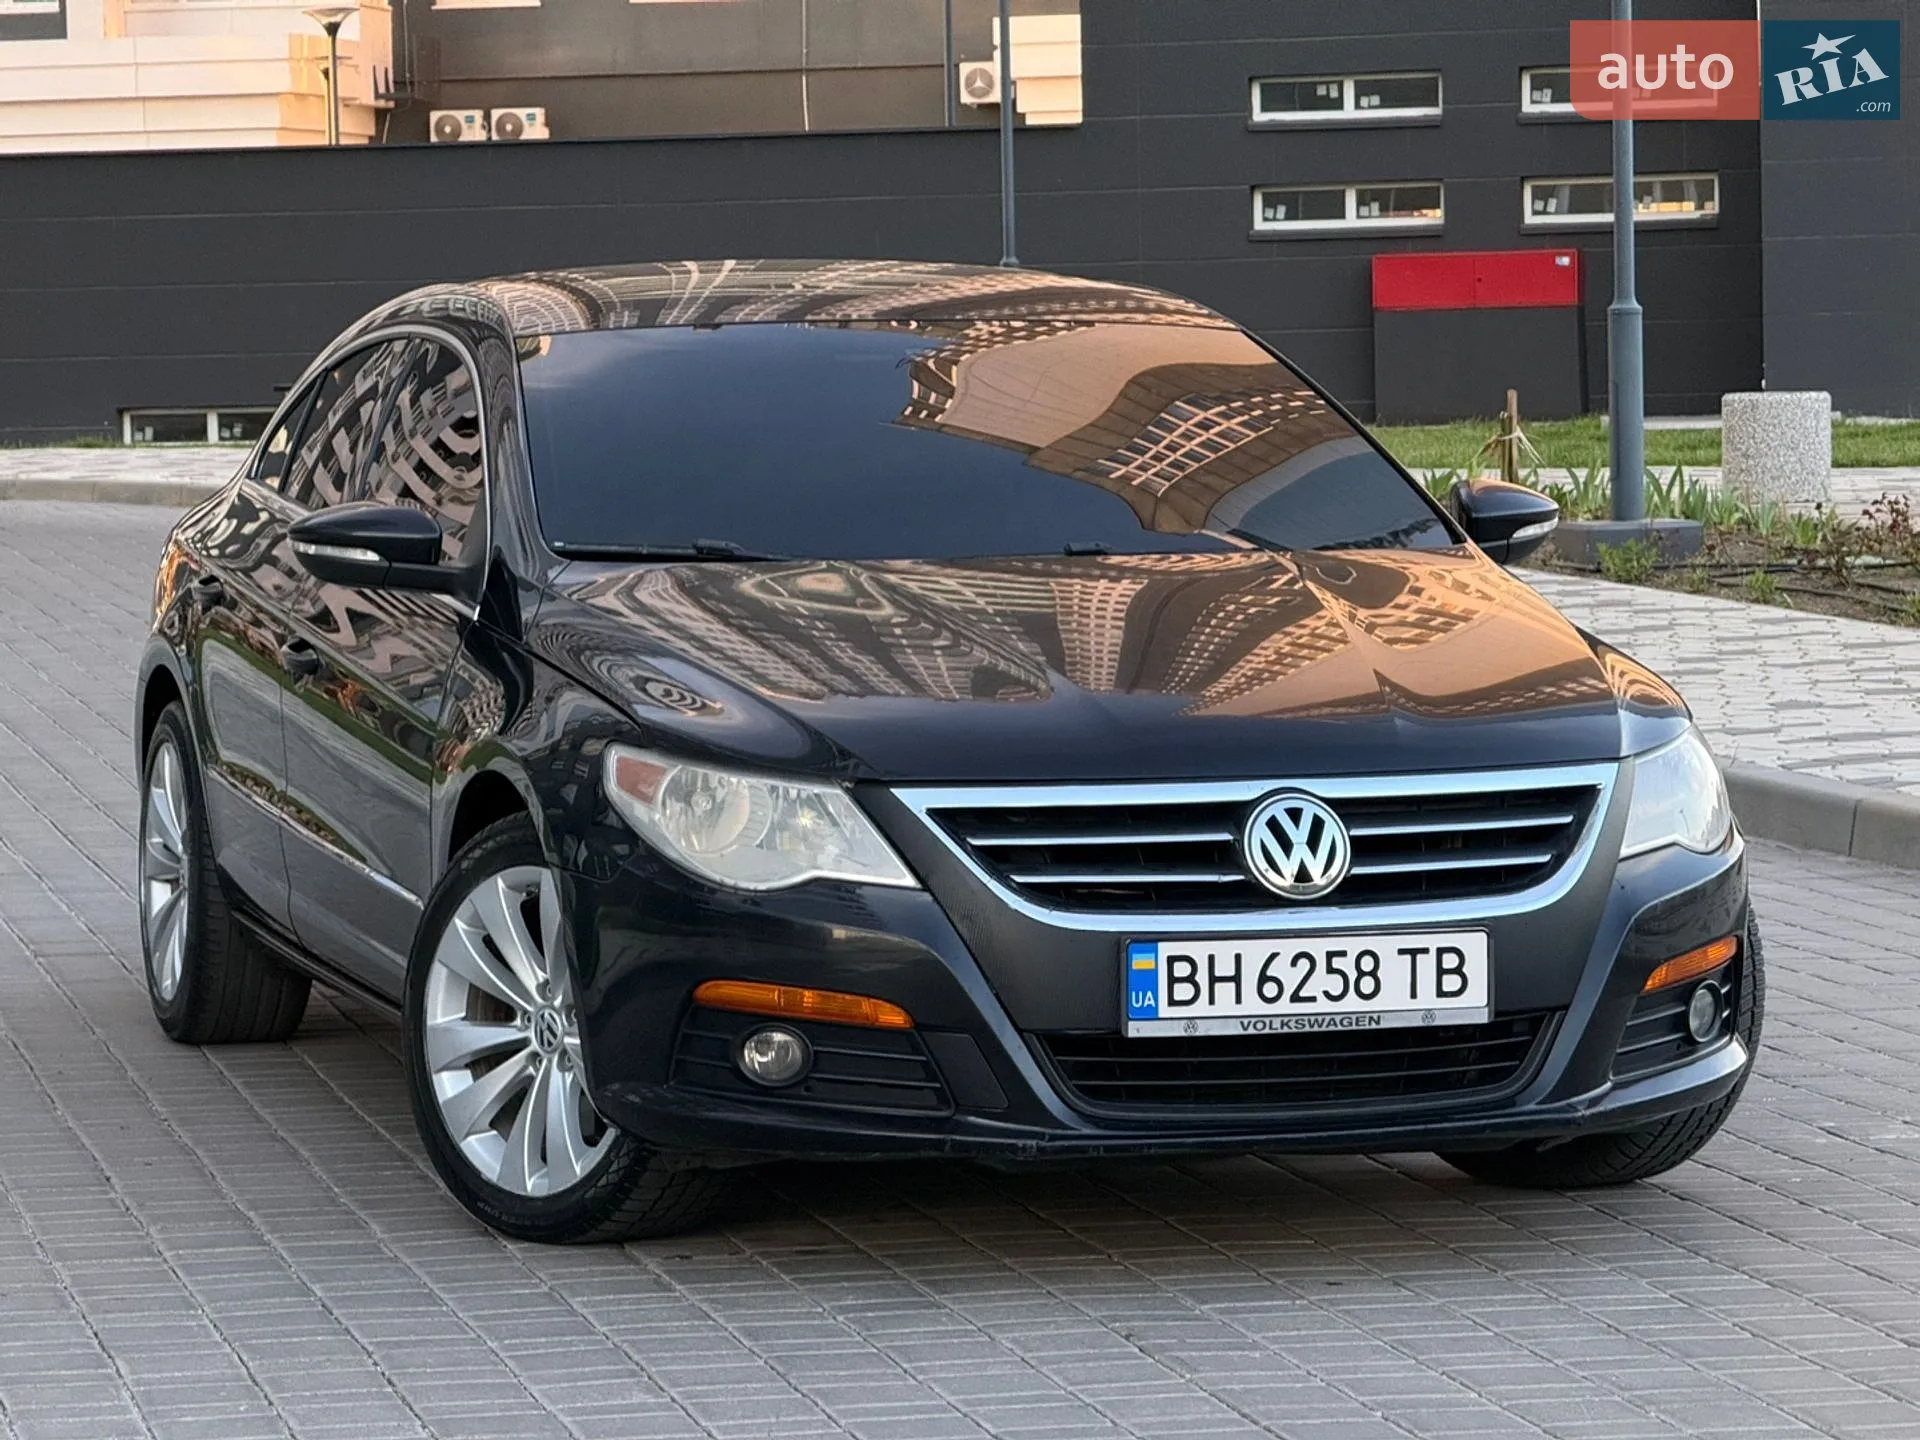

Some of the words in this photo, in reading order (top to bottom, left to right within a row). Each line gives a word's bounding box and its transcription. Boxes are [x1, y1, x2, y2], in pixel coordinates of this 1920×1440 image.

[1166, 952, 1242, 1008] BH
[1256, 949, 1382, 1004] 6258
[1397, 946, 1468, 999] TB
[1131, 990, 1156, 1008] UA
[1239, 1014, 1382, 1033] VOLKSWAGEN
